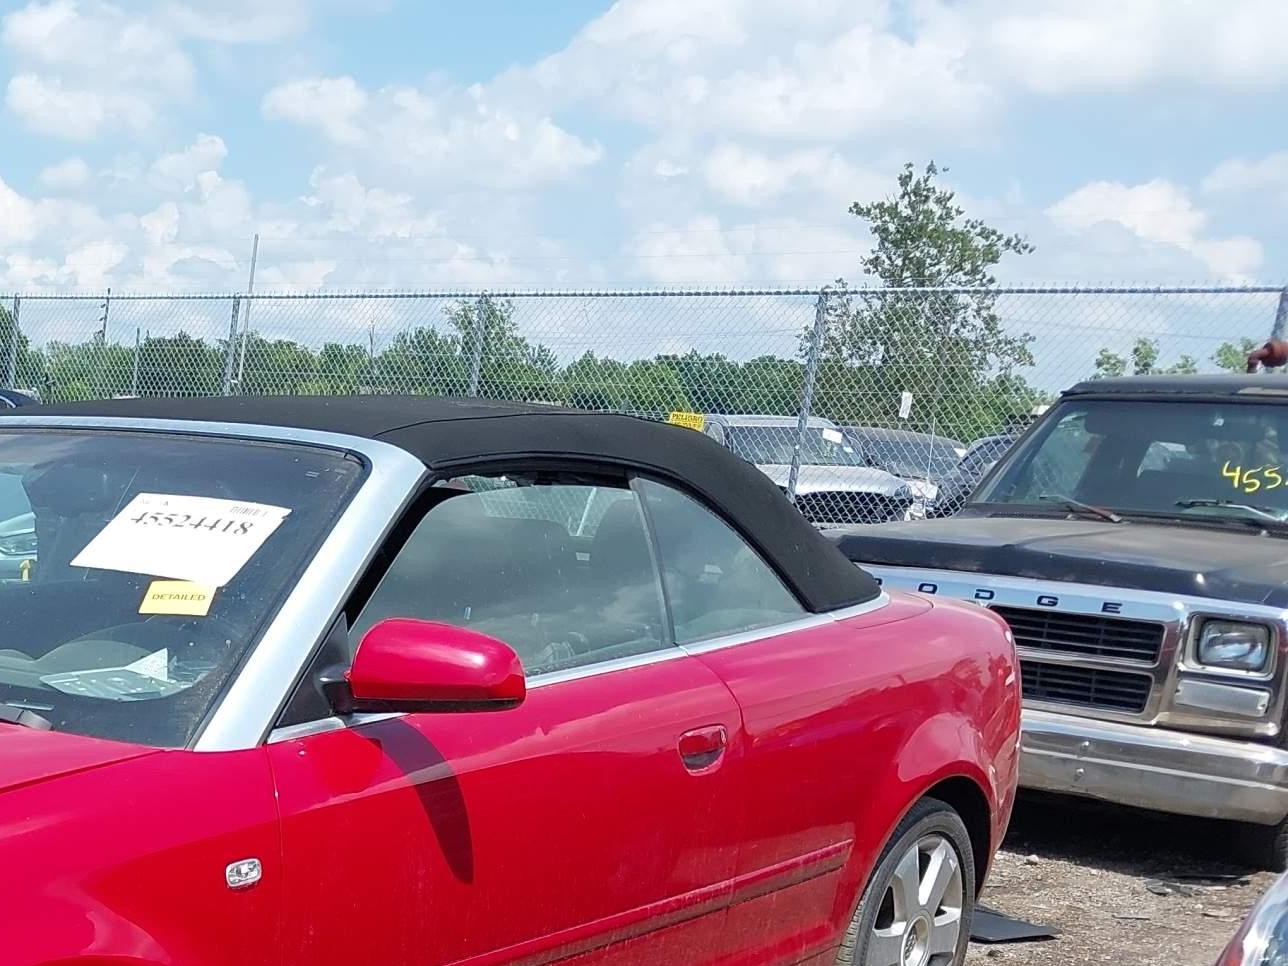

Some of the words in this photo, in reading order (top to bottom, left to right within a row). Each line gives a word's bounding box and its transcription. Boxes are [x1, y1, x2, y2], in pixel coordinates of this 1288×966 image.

[1222, 459, 1288, 493] 455
[130, 510, 255, 536] 45524418
[152, 593, 206, 601] DETAILED
